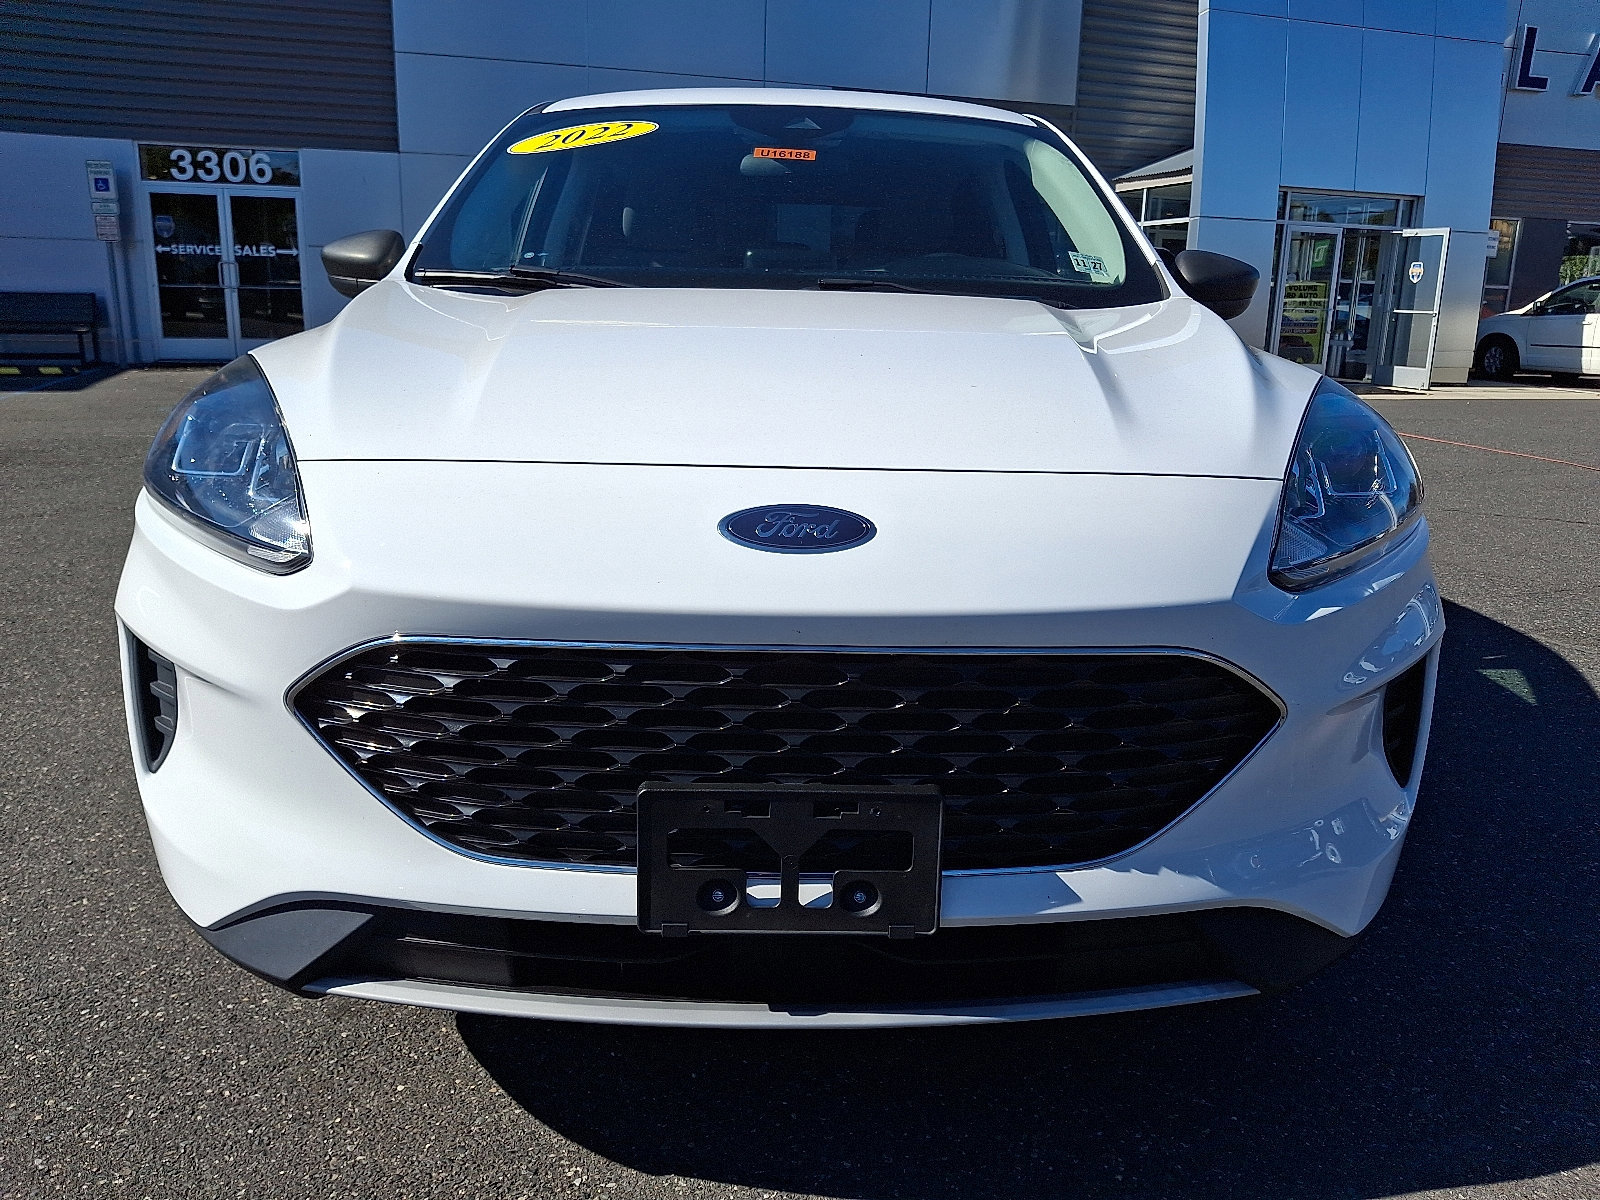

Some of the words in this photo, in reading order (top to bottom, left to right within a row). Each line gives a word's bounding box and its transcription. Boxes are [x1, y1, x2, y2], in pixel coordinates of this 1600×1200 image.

[534, 123, 634, 151] 2022
[760, 149, 811, 159] U16188
[169, 149, 274, 184] 3306
[170, 243, 222, 256] SERVICE
[234, 245, 277, 257] SALES
[1090, 261, 1103, 271] 27
[1288, 284, 1318, 292] VOLUME
[755, 511, 841, 539] Ford
